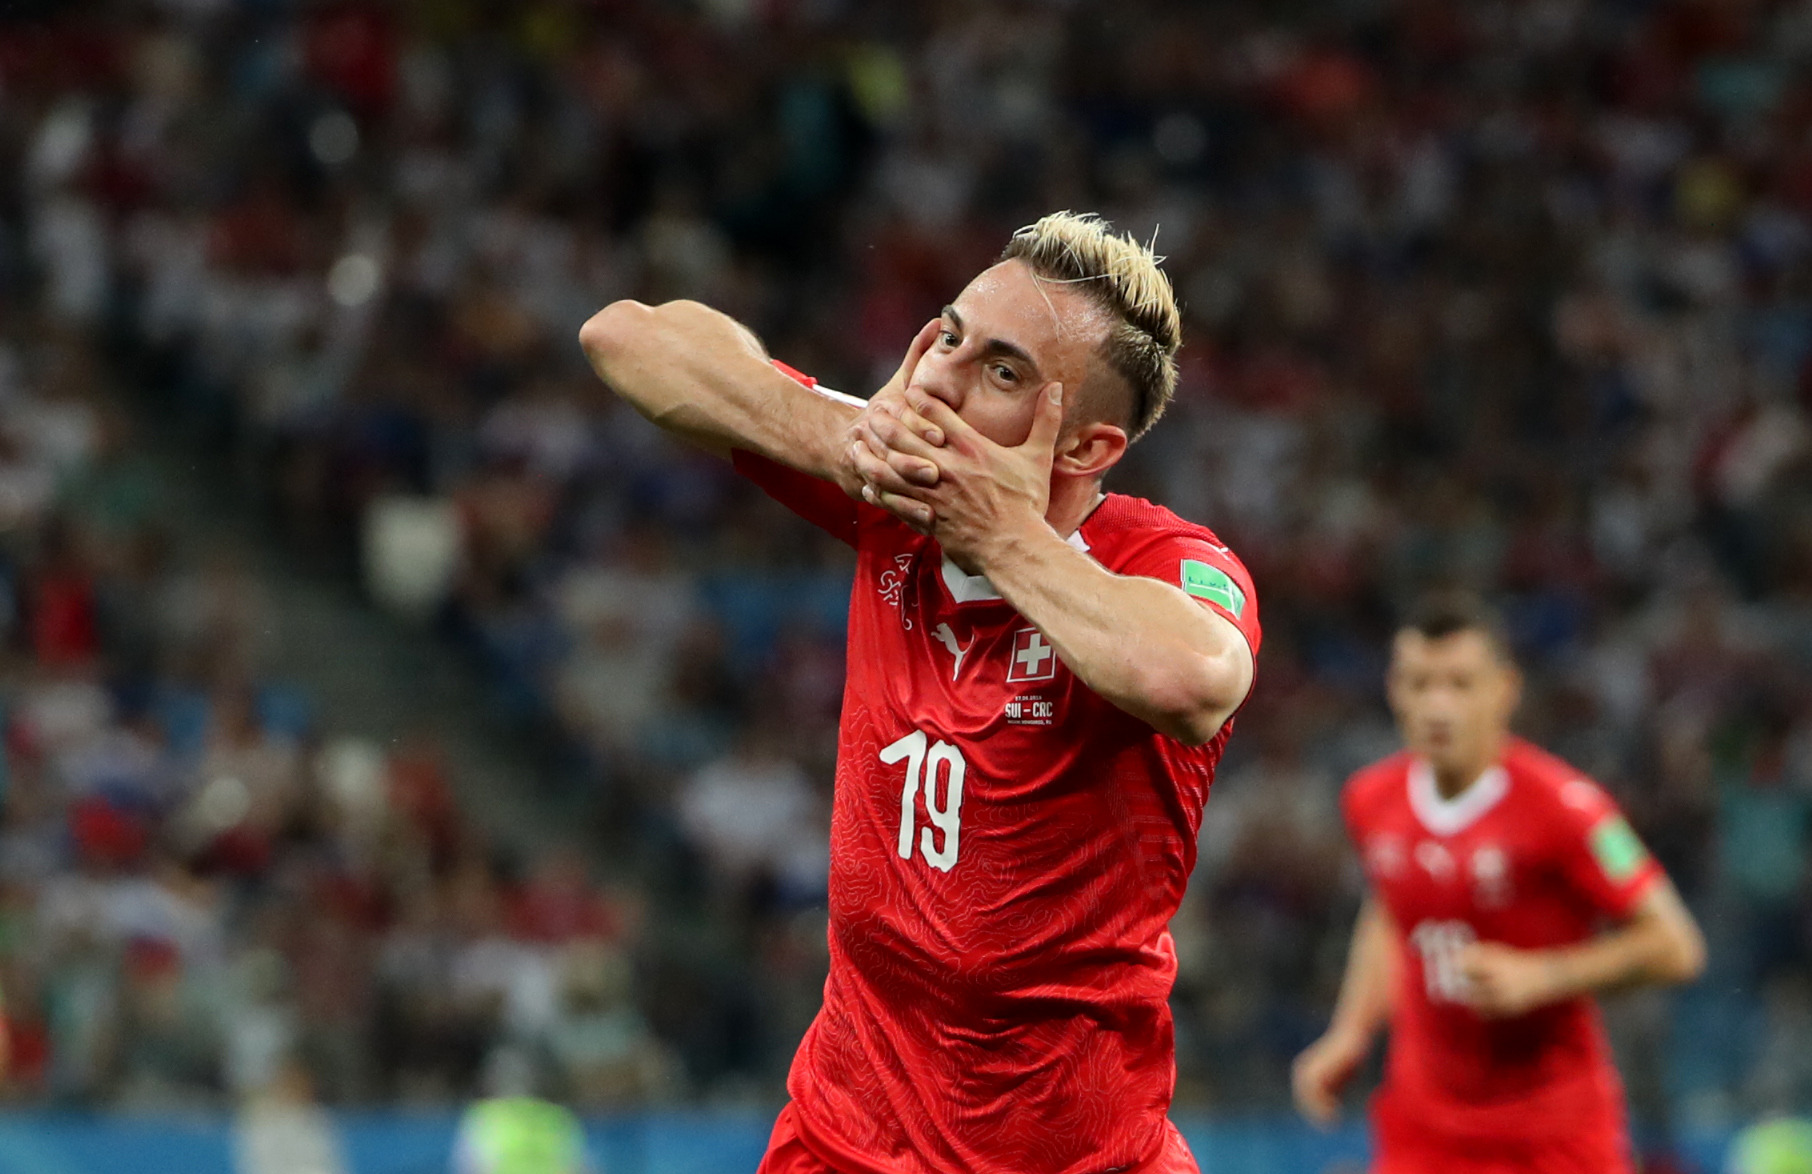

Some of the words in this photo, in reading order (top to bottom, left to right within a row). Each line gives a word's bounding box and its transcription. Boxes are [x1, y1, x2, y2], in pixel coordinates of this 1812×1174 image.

[1005, 703, 1021, 718] SUI
[1032, 702, 1053, 717] CRC
[879, 729, 966, 873] 19
